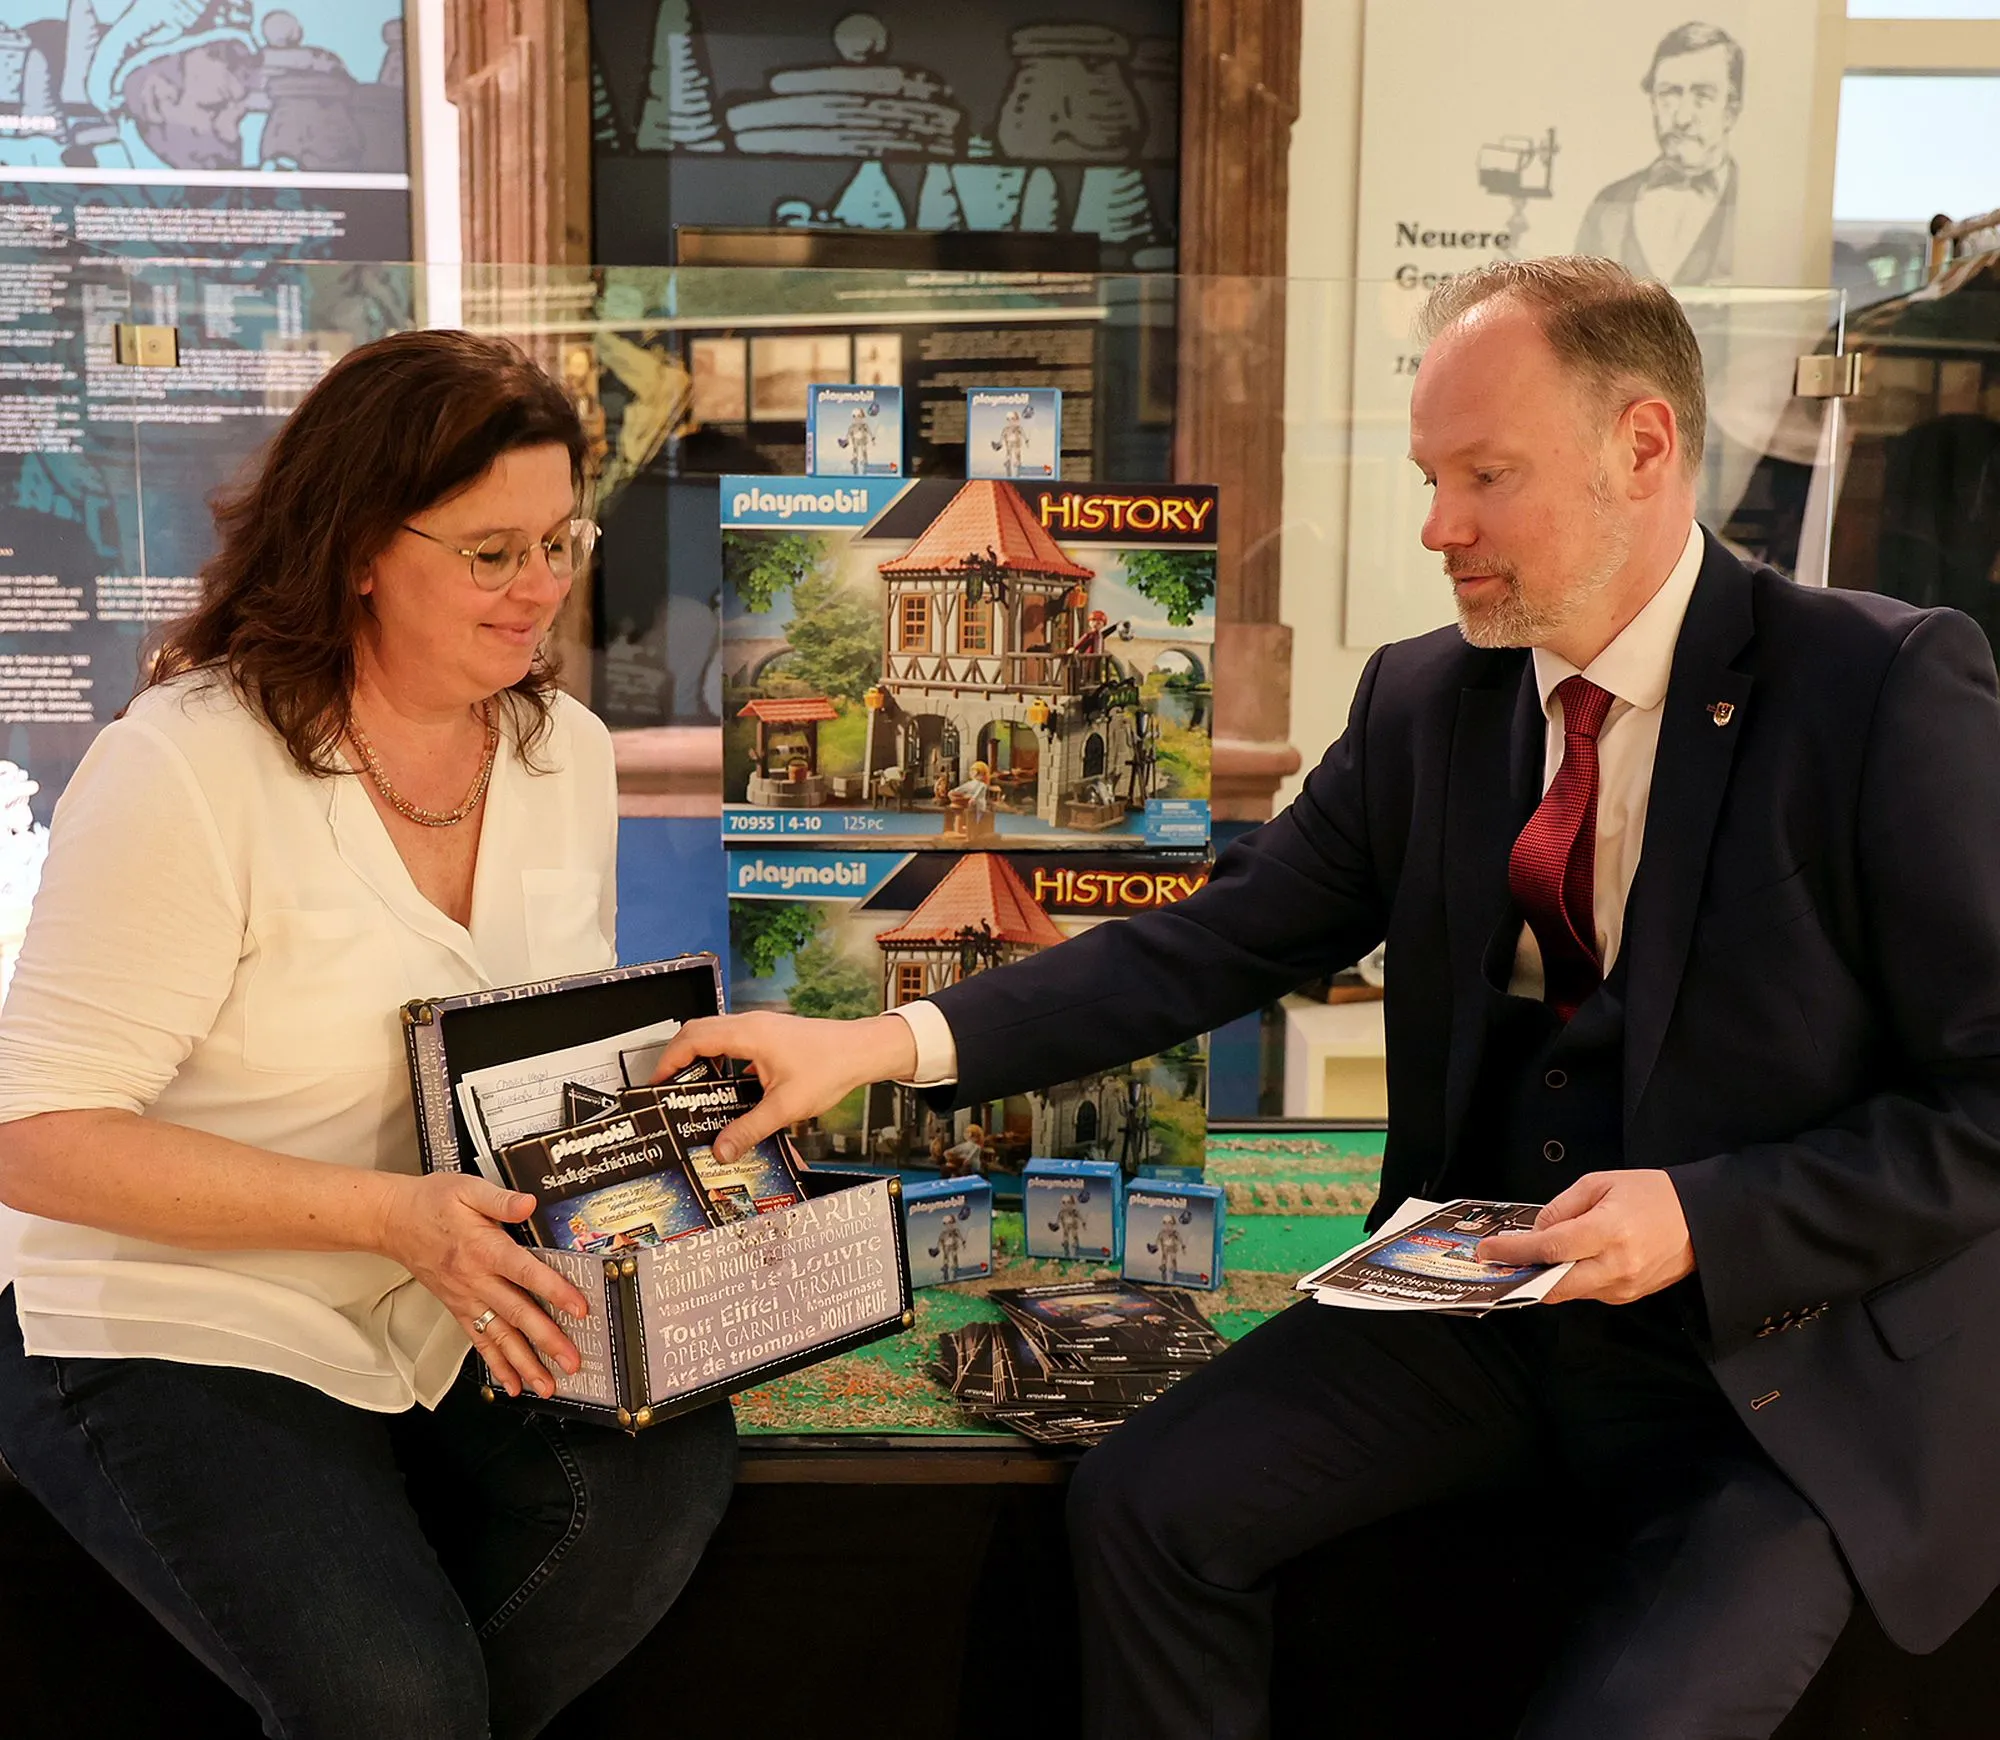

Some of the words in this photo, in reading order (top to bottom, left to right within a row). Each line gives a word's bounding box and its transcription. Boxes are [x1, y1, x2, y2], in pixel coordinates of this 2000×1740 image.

[1395, 221, 1511, 249] Neuere
[818, 389, 875, 403] playmobil
[972, 393, 1029, 407] playmobil
[733, 489, 868, 518] playmobil
[1040, 495, 1211, 532] HISTORY
[730, 816, 775, 831] 70955
[788, 816, 822, 831] 4-10
[739, 860, 867, 888] playmobil
[1033, 870, 1208, 905] HISTORY
[551, 1120, 637, 1165] playmobil
[541, 1143, 664, 1190] Stadtgeschichte(n)
[1027, 1176, 1084, 1190] playmobil
[909, 1194, 965, 1216] playmobil
[1129, 1193, 1188, 1208] playmobil
[655, 1265, 716, 1301] MOULIN
[719, 1247, 769, 1281] ROUGE
[790, 1235, 882, 1279] Louvre
[786, 1256, 884, 1304] VERSAILLES
[806, 1278, 884, 1312] Montparnasse
[659, 1281, 746, 1317] Montmartre
[820, 1300, 853, 1331] PONT
[855, 1289, 888, 1321] NEUF
[659, 1315, 715, 1349] Tour
[725, 1307, 803, 1348] GARNIER
[702, 1357, 727, 1377] de
